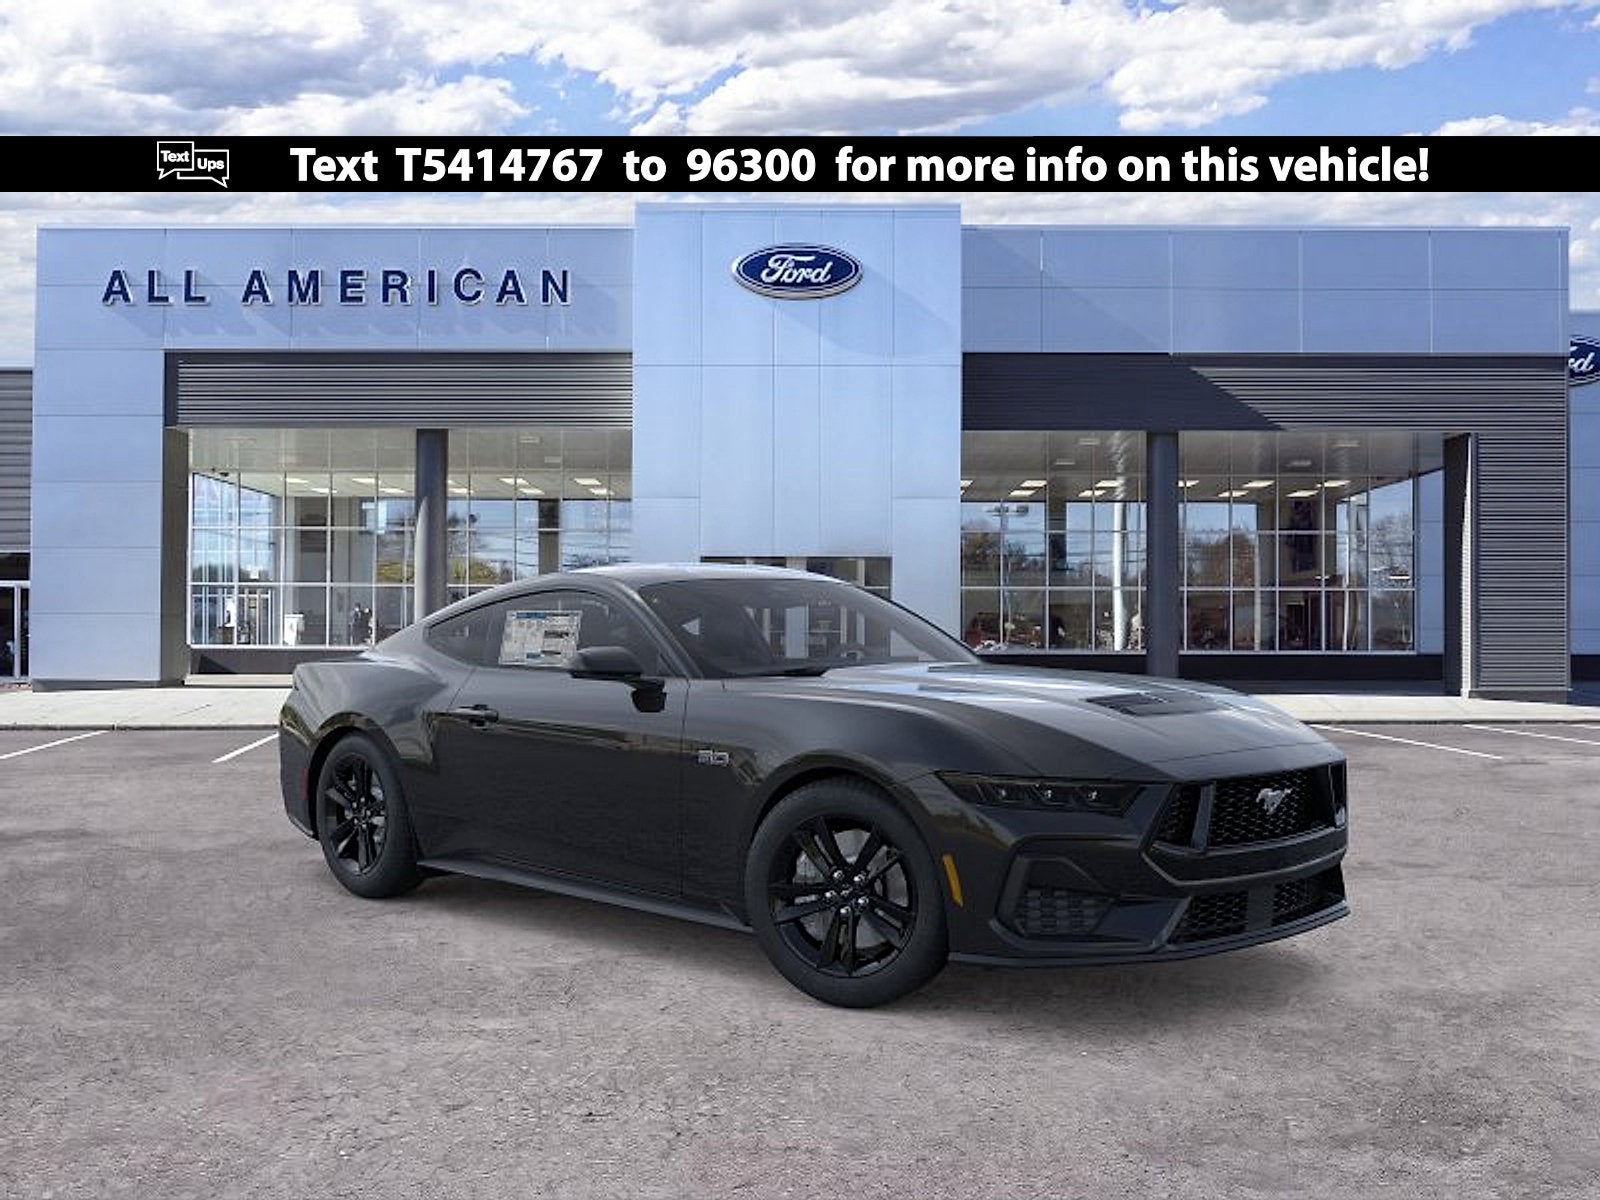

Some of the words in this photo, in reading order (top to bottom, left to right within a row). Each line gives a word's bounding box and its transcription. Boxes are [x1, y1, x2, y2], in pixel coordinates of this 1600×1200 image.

[761, 254, 833, 282] Ford
[102, 270, 209, 305] ALL
[242, 268, 571, 305] AMERICAN
